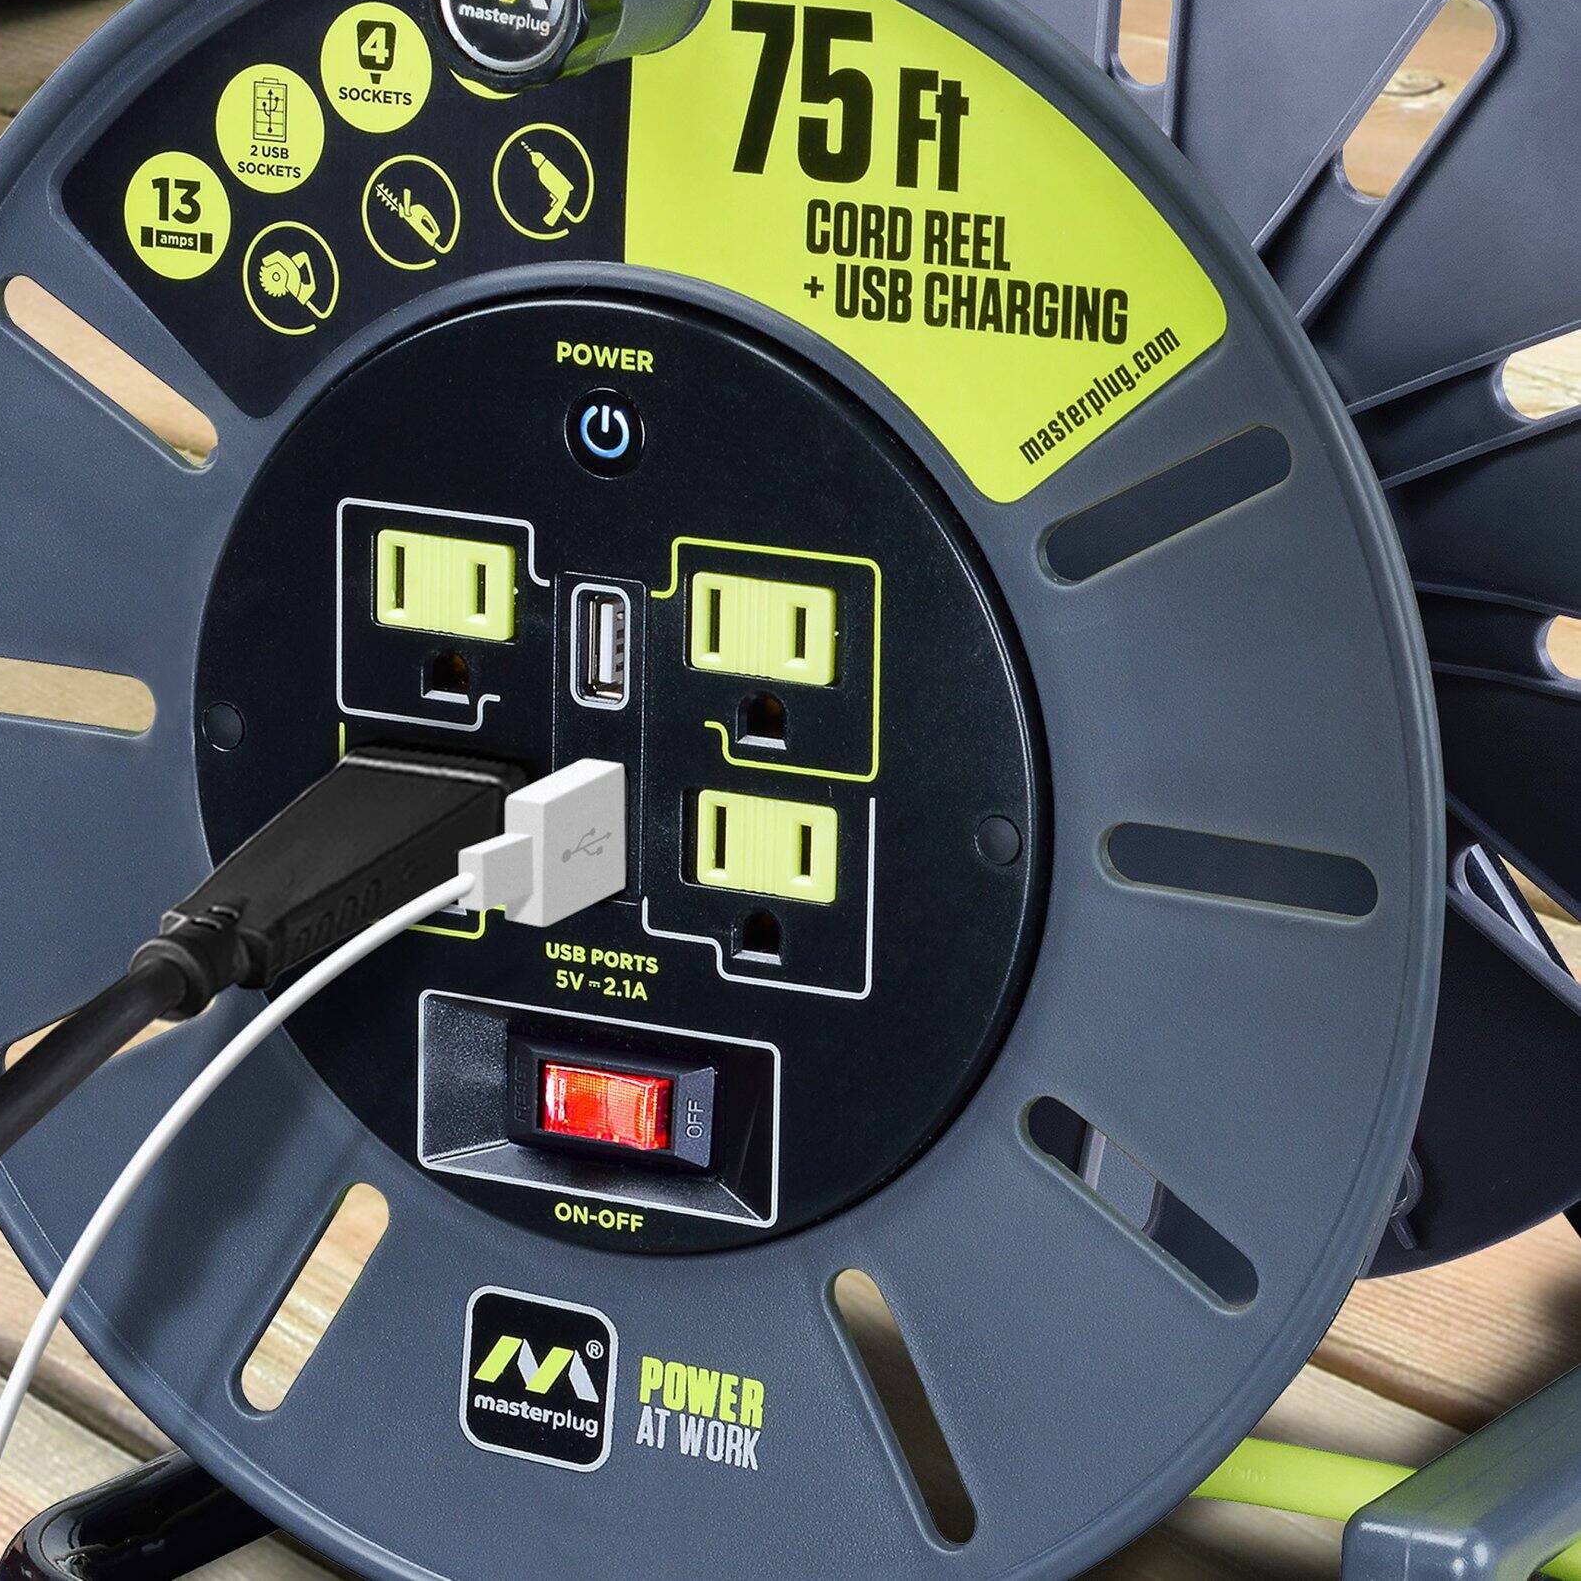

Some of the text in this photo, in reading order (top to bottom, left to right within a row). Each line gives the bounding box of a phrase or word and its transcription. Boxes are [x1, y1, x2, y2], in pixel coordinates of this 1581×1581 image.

[459, 4, 550, 36] masterplug
[361, 27, 390, 65] 4
[338, 86, 412, 106] SOCKETS
[731, 0, 970, 192] 75 Ft
[238, 162, 301, 178] SOCKETS
[250, 145, 289, 159] 2 USB
[152, 177, 201, 224] 13
[160, 234, 194, 247] amps
[806, 198, 1011, 272] CORD REEL
[803, 263, 1129, 345] + USB CHARGING
[556, 341, 654, 373] POWER
[1019, 327, 1181, 465] masterplug.com
[545, 942, 659, 974] USB PORTS
[686, 1100, 705, 1139] OFF
[554, 1201, 644, 1233] ON-OFF
[639, 1356, 764, 1428] POWER
[473, 1394, 599, 1438] masterplug
[636, 1406, 760, 1470] AT WORK
